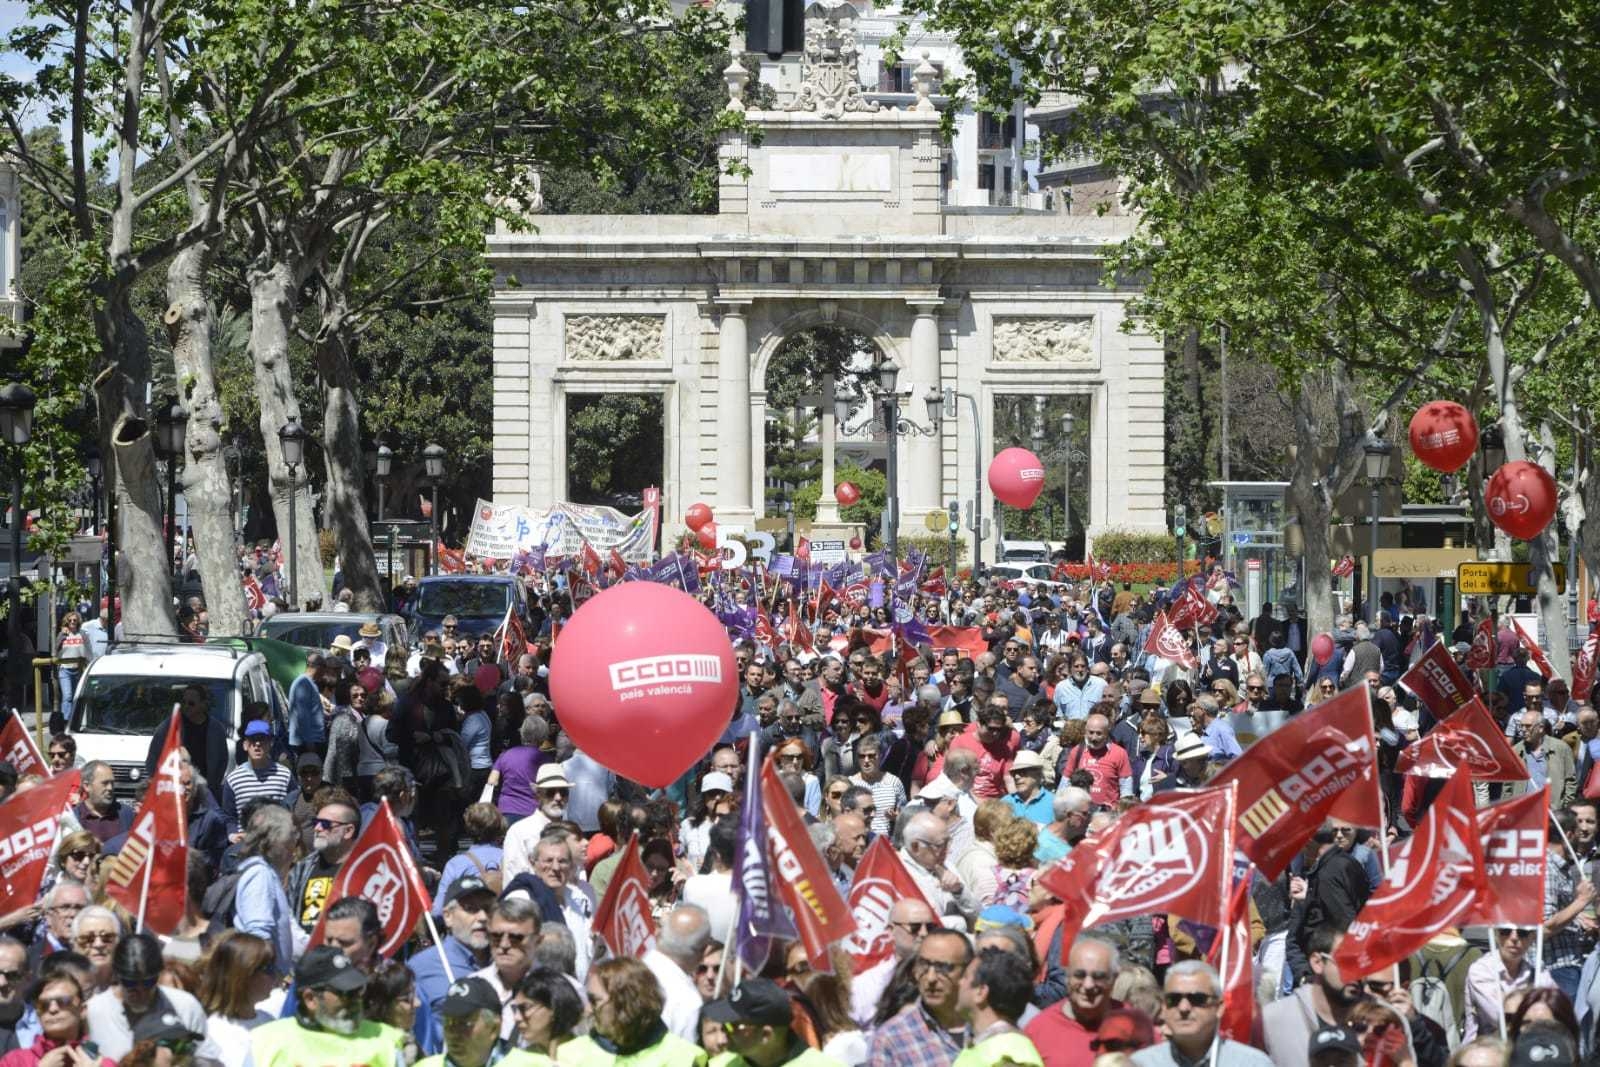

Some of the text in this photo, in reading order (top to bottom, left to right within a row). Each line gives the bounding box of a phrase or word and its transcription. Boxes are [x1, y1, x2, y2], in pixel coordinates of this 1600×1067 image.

[716, 525, 775, 570] 53
[811, 542, 824, 551] 53
[1462, 568, 1488, 577] Porta
[617, 659, 692, 684] CCOO
[1424, 658, 1457, 693] CCOO
